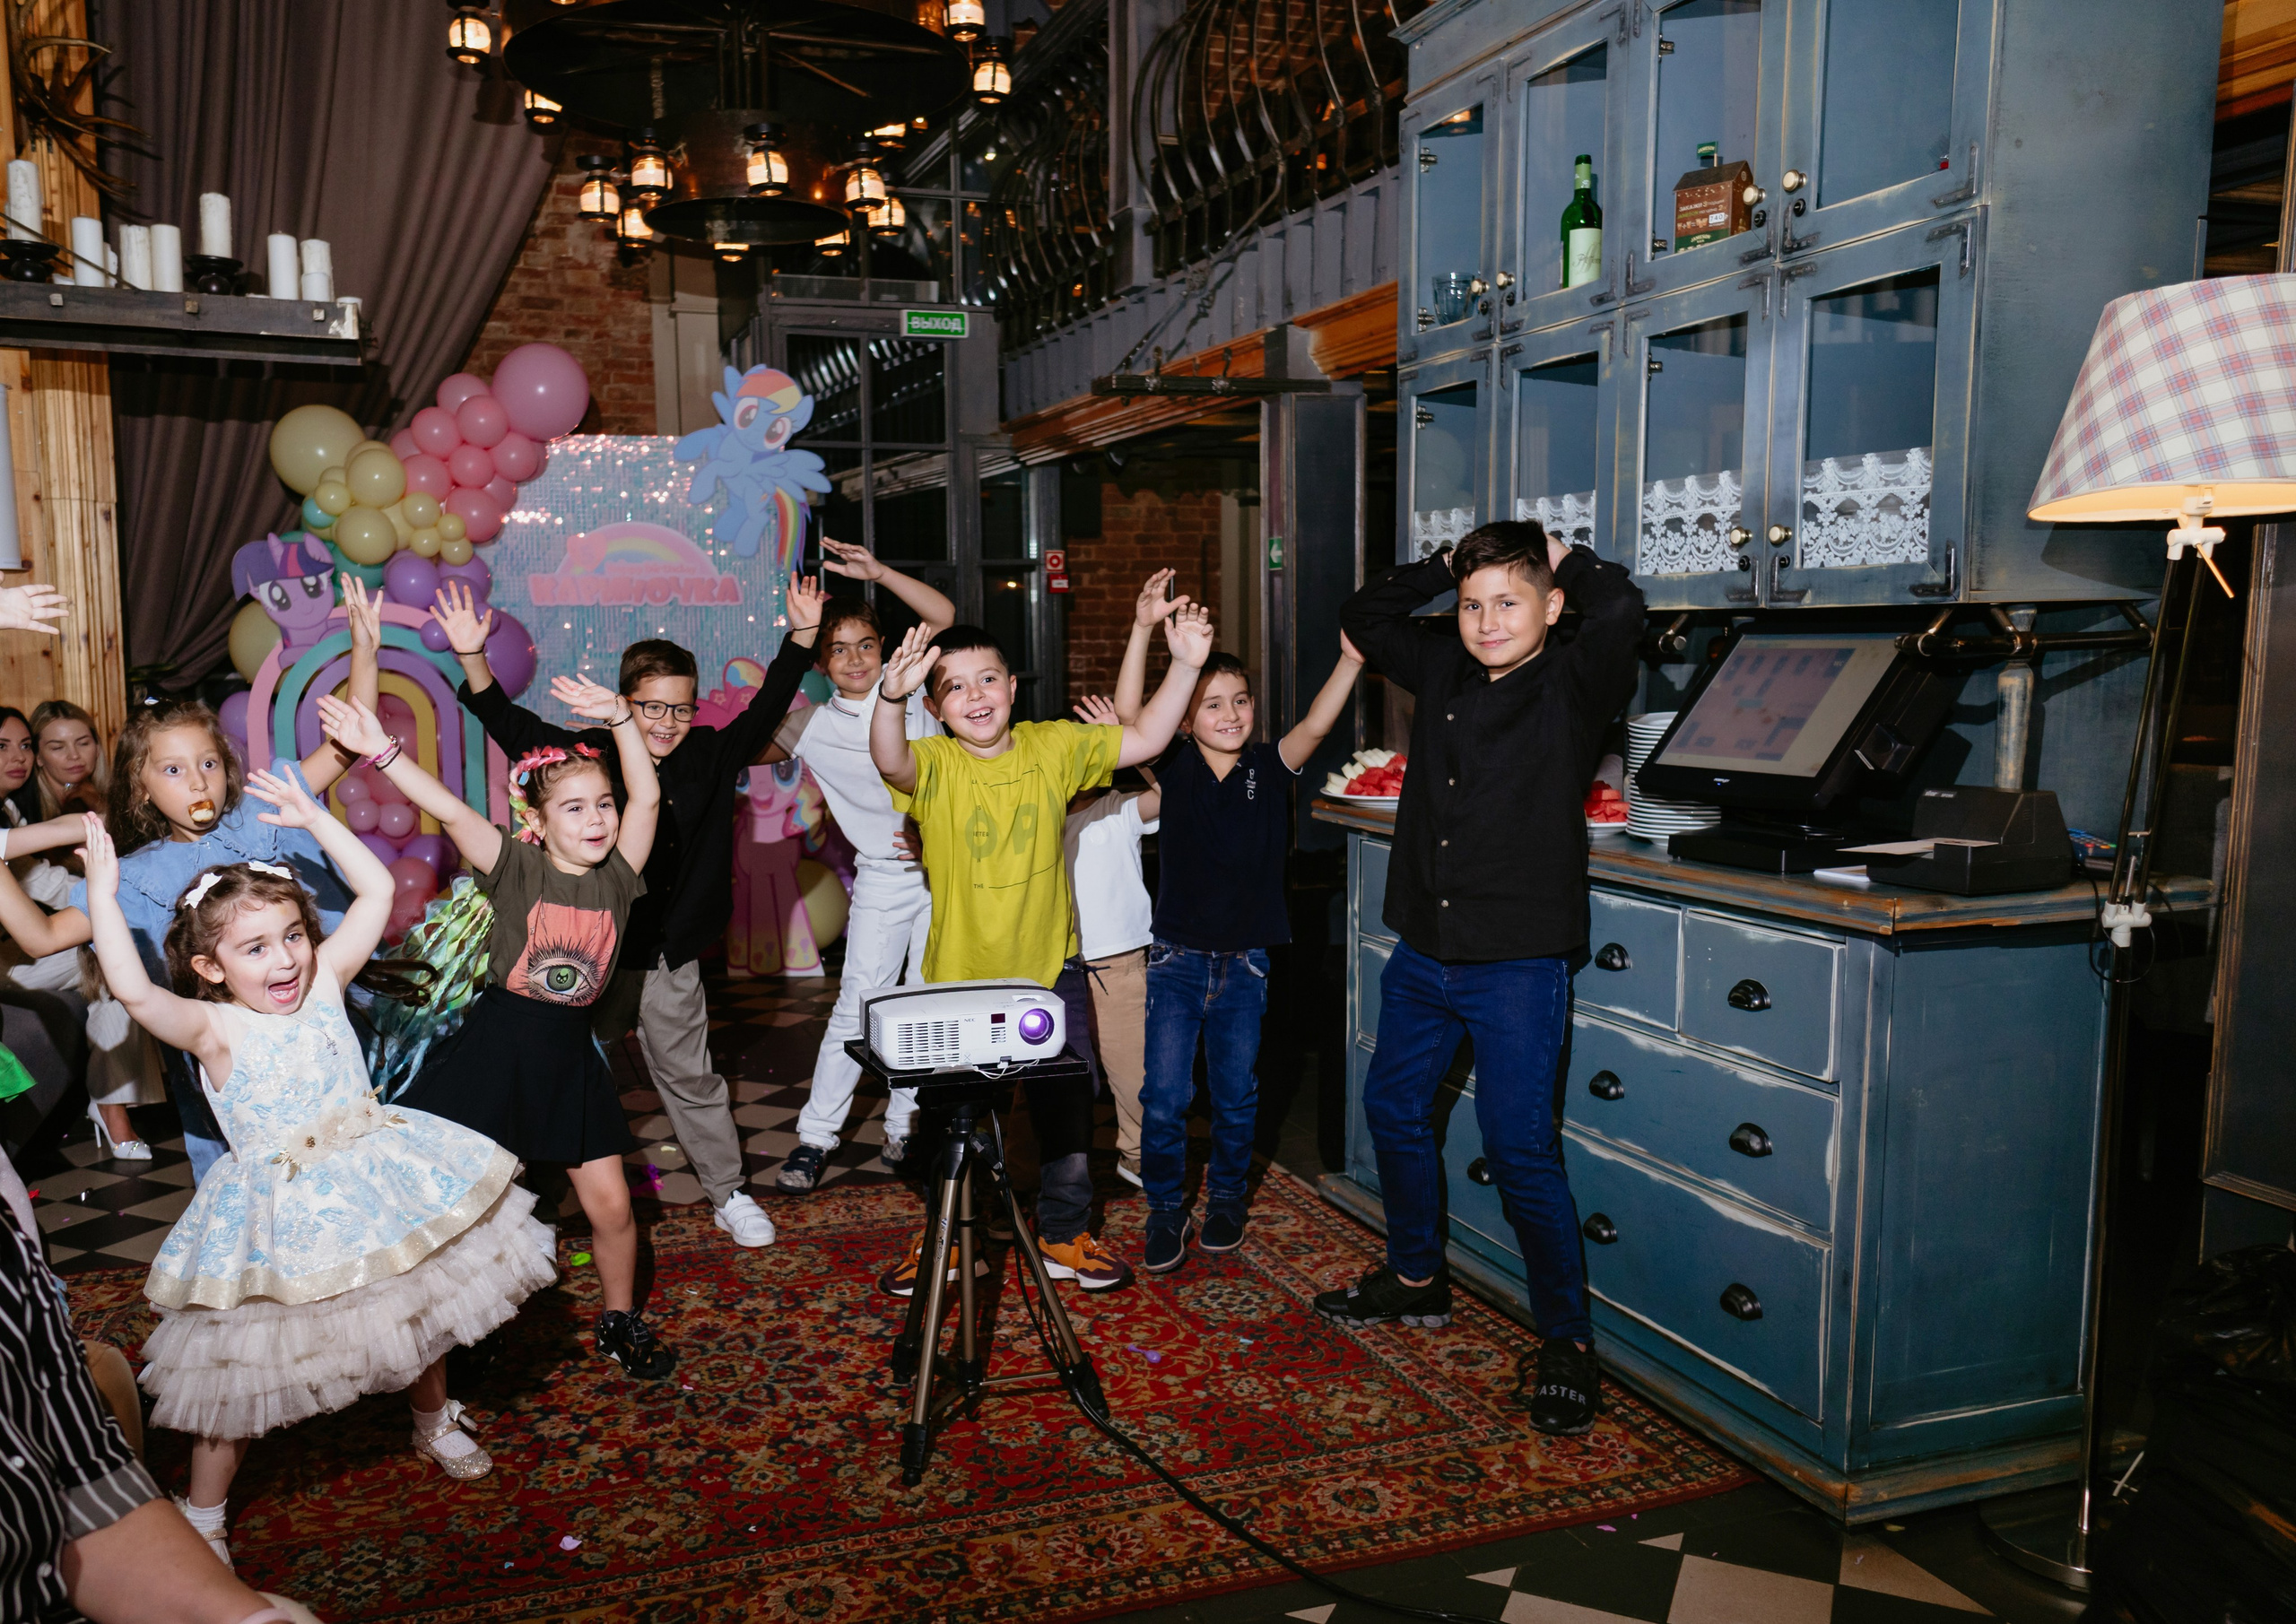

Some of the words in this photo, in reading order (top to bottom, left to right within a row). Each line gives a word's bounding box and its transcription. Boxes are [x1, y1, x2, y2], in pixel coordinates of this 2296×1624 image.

[1710, 214, 1723, 222] 740
[911, 317, 962, 333] ВЫХОД
[532, 575, 740, 604] КАРИНОЧКА
